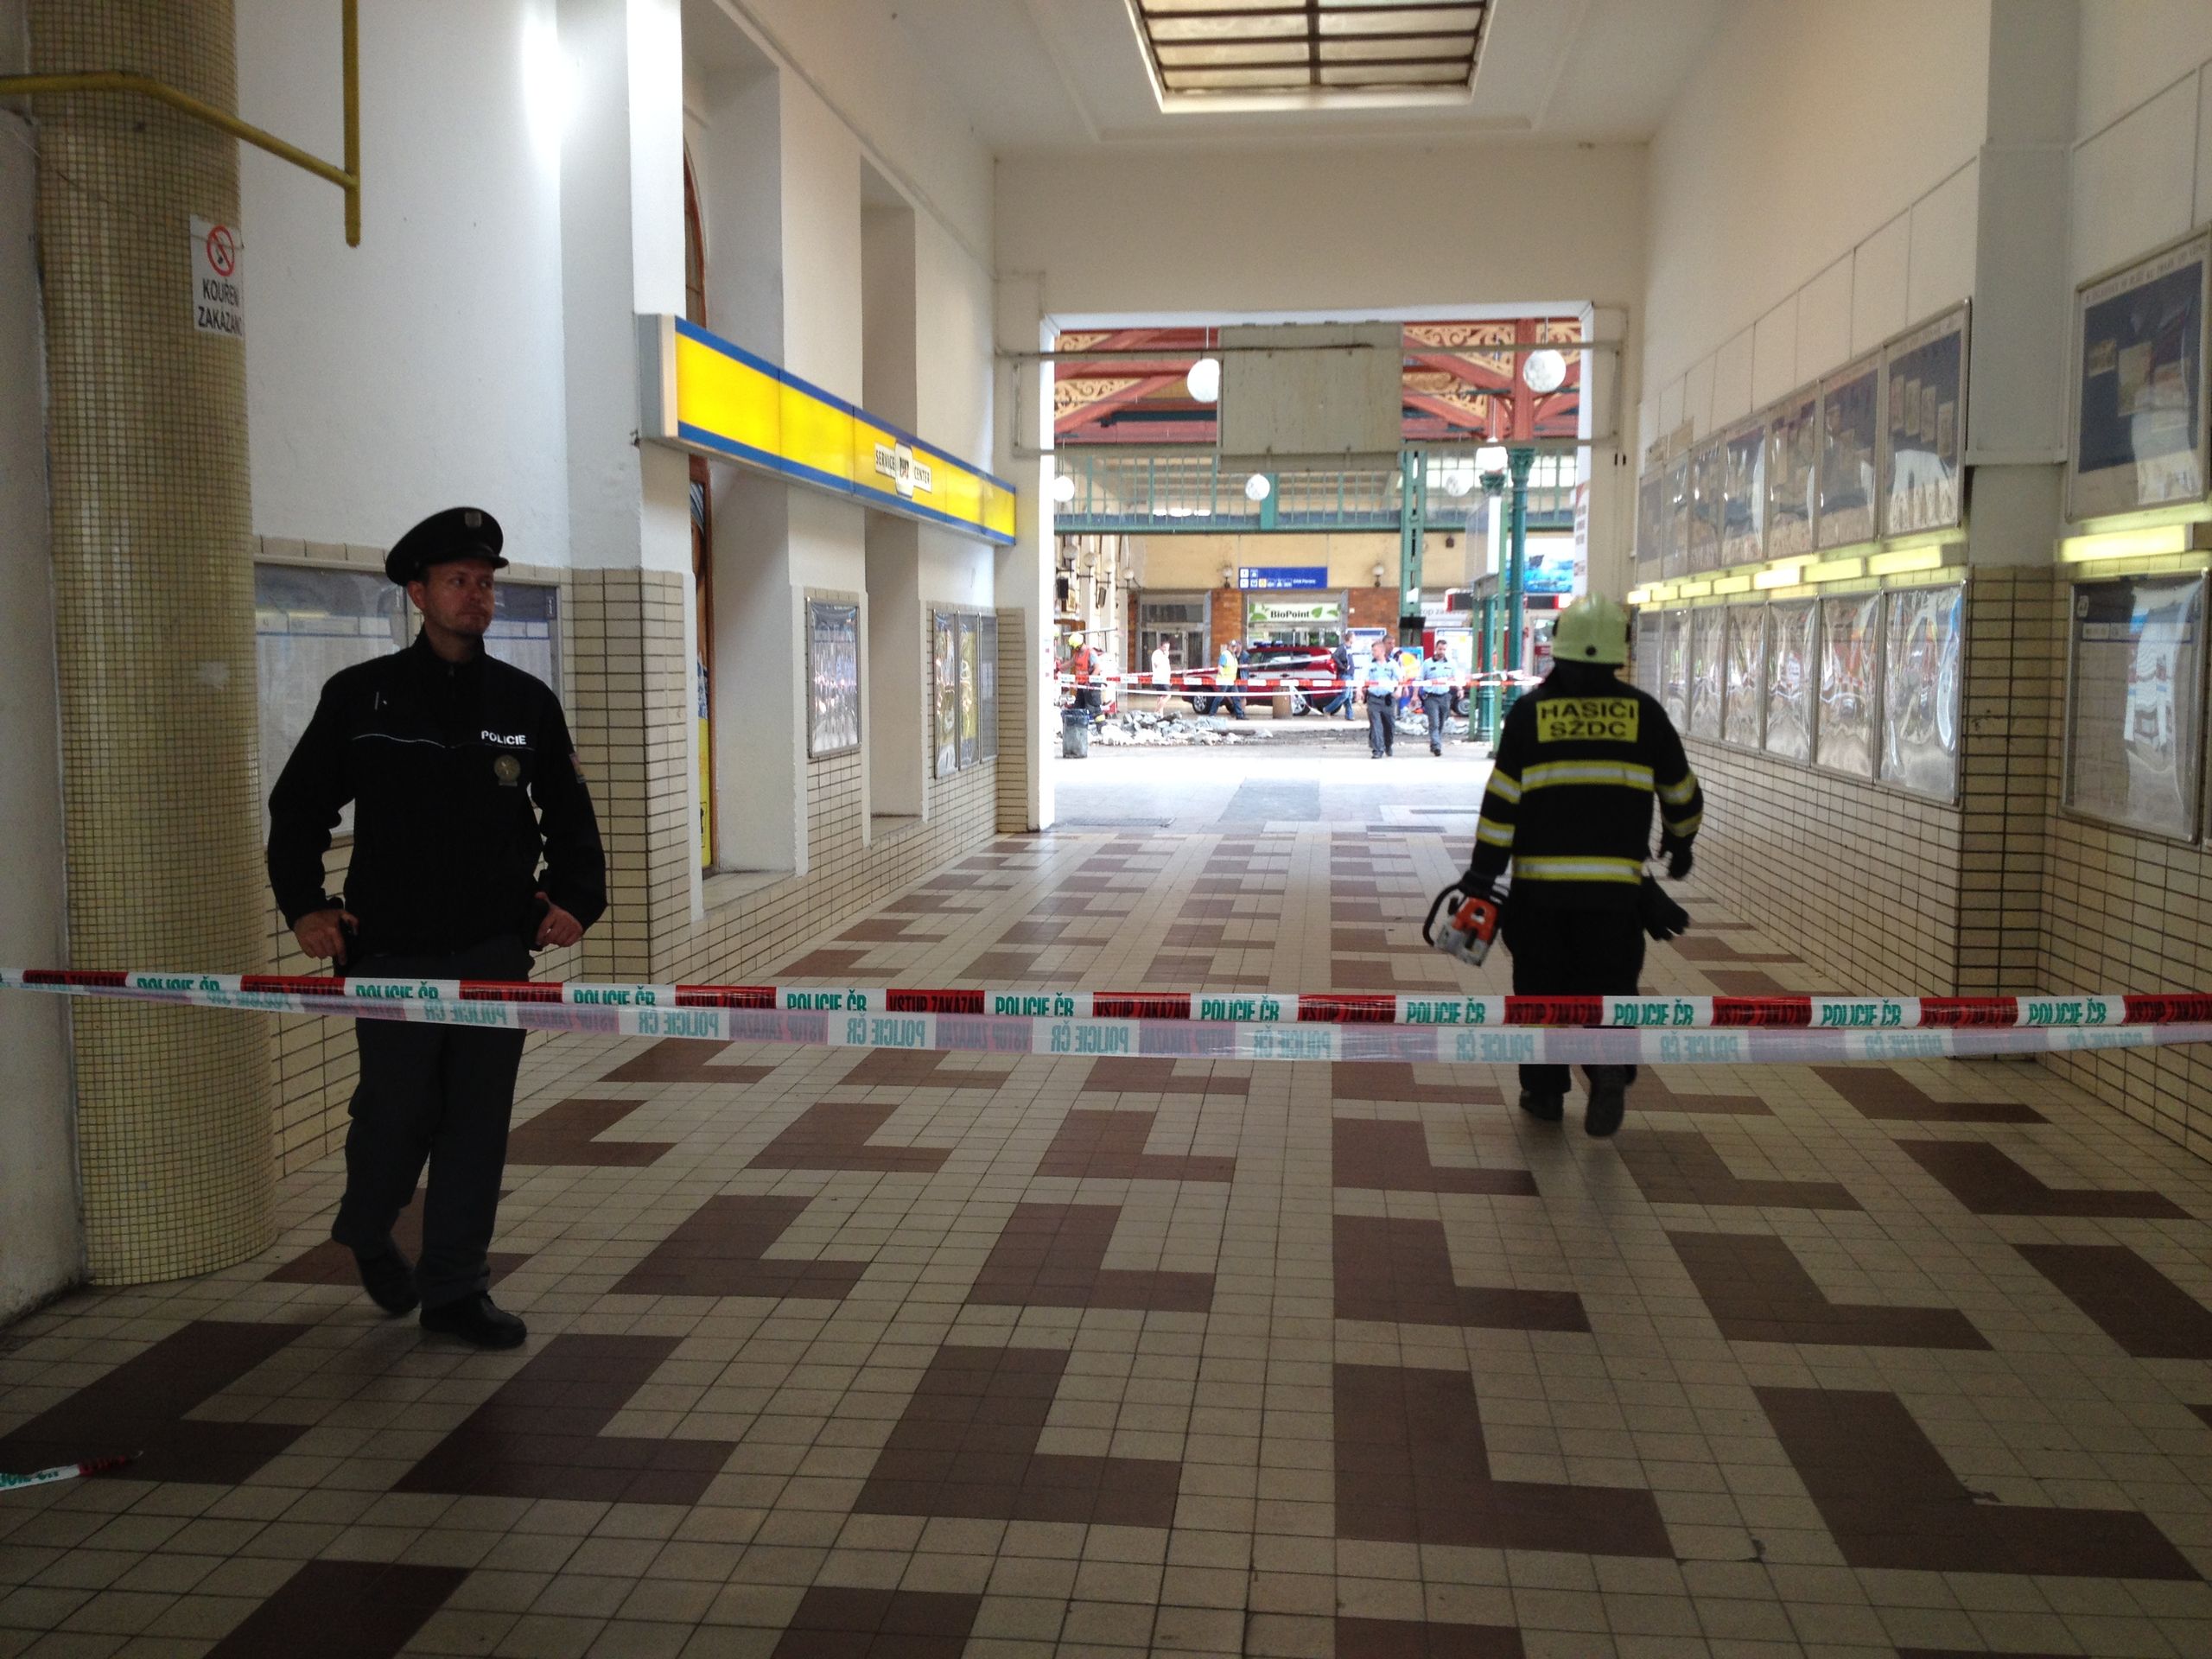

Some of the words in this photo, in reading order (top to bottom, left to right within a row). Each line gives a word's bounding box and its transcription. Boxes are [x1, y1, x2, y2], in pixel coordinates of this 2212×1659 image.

[875, 449, 895, 471] SERVICE
[913, 466, 931, 485] CENTER
[1270, 610, 1310, 619] BioPoint
[481, 730, 527, 745] POLICIE
[787, 994, 842, 1010] POLICIE
[995, 996, 1050, 1016] POLICIE
[1054, 992, 1074, 1016] ČR
[1201, 999, 1255, 1020] POLICIE
[1259, 995, 1280, 1021] ČR
[1407, 1001, 1460, 1023] POLICIE
[1465, 997, 1485, 1024] ČR
[1613, 1003, 1669, 1026] POLICIE
[1673, 999, 1694, 1026] ČR
[1821, 1004, 1878, 1027] POLICIE
[1880, 1000, 1901, 1027] ČR
[2027, 1002, 2082, 1024] POLICIE
[2085, 998, 2107, 1024] ČR
